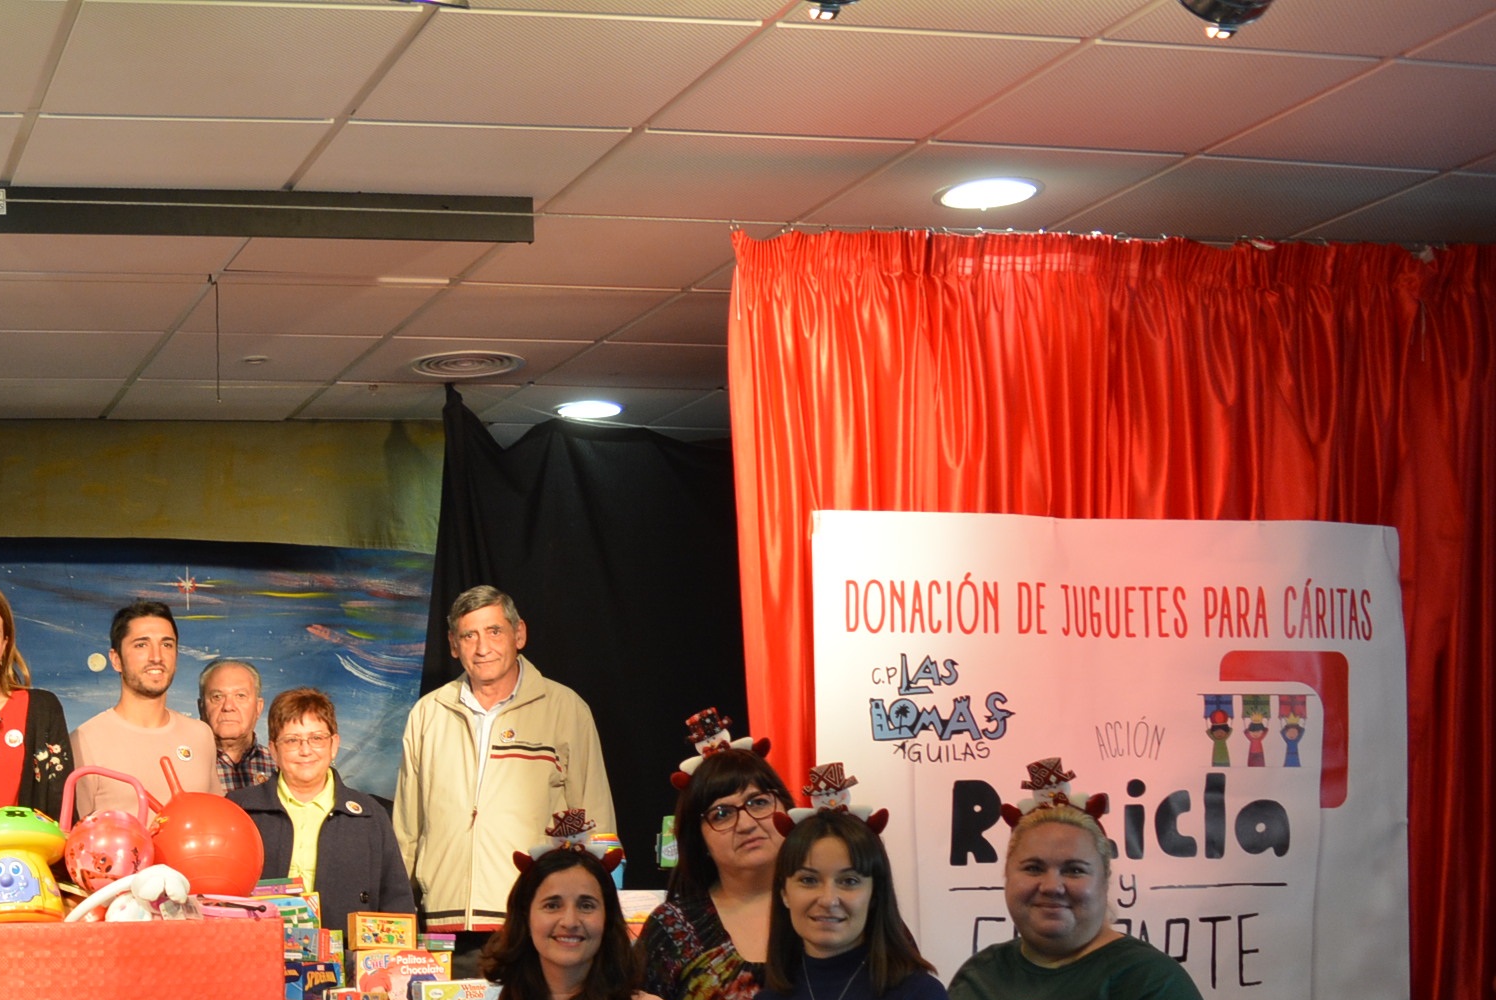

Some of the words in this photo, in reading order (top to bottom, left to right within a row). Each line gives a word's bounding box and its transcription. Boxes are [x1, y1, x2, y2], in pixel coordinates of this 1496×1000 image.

[845, 573, 999, 634] DONACIÓN
[1017, 581, 1046, 635] DE
[1060, 584, 1187, 638] JUGUETES
[1204, 586, 1269, 639] PARA
[1284, 578, 1372, 642] CÁRITAS
[898, 653, 959, 696] LAS
[869, 691, 1016, 741] LOMAS
[1096, 718, 1165, 761] ACCIÓN
[1117, 874, 1137, 907] y
[396, 954, 426, 964] Palitos
[400, 965, 444, 975] Chocolate
[461, 984, 487, 992] Winnie
[465, 990, 485, 999] Pooh
